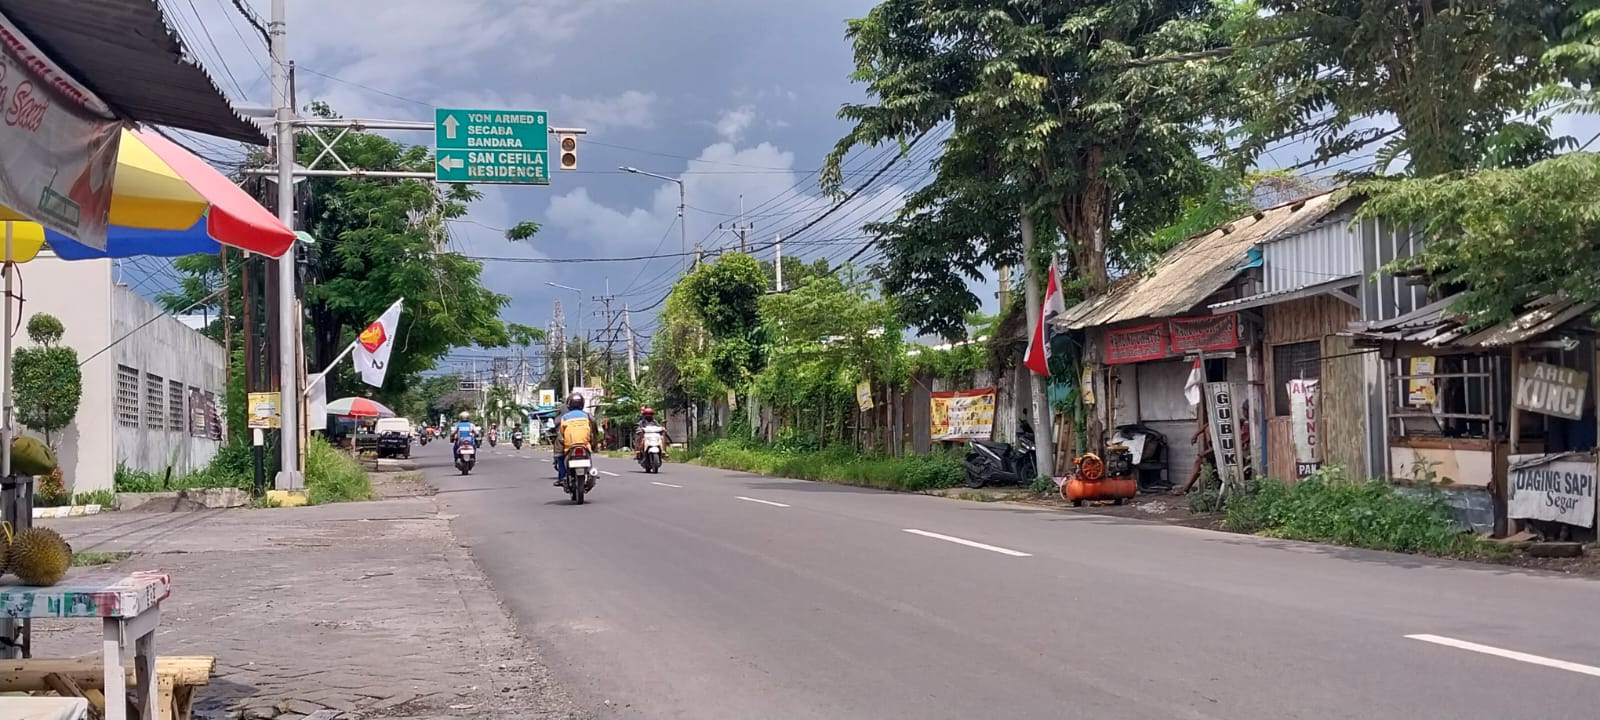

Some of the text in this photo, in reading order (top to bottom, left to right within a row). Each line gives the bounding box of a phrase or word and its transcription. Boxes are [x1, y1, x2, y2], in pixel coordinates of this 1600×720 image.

[468, 113, 544, 125] YON ARMED 8
[468, 125, 513, 135] SECABA
[468, 137, 523, 147] BANDARA
[468, 152, 543, 164] SAN CEFILA
[468, 166, 543, 177] RESIDENCE
[371, 358, 384, 370] 2
[1534, 366, 1573, 384] AHLI
[1516, 377, 1585, 416] KUNCI
[1216, 393, 1237, 465] GUBUK
[1516, 469, 1592, 497] DAGING SAPI
[1545, 490, 1579, 514] Segar
